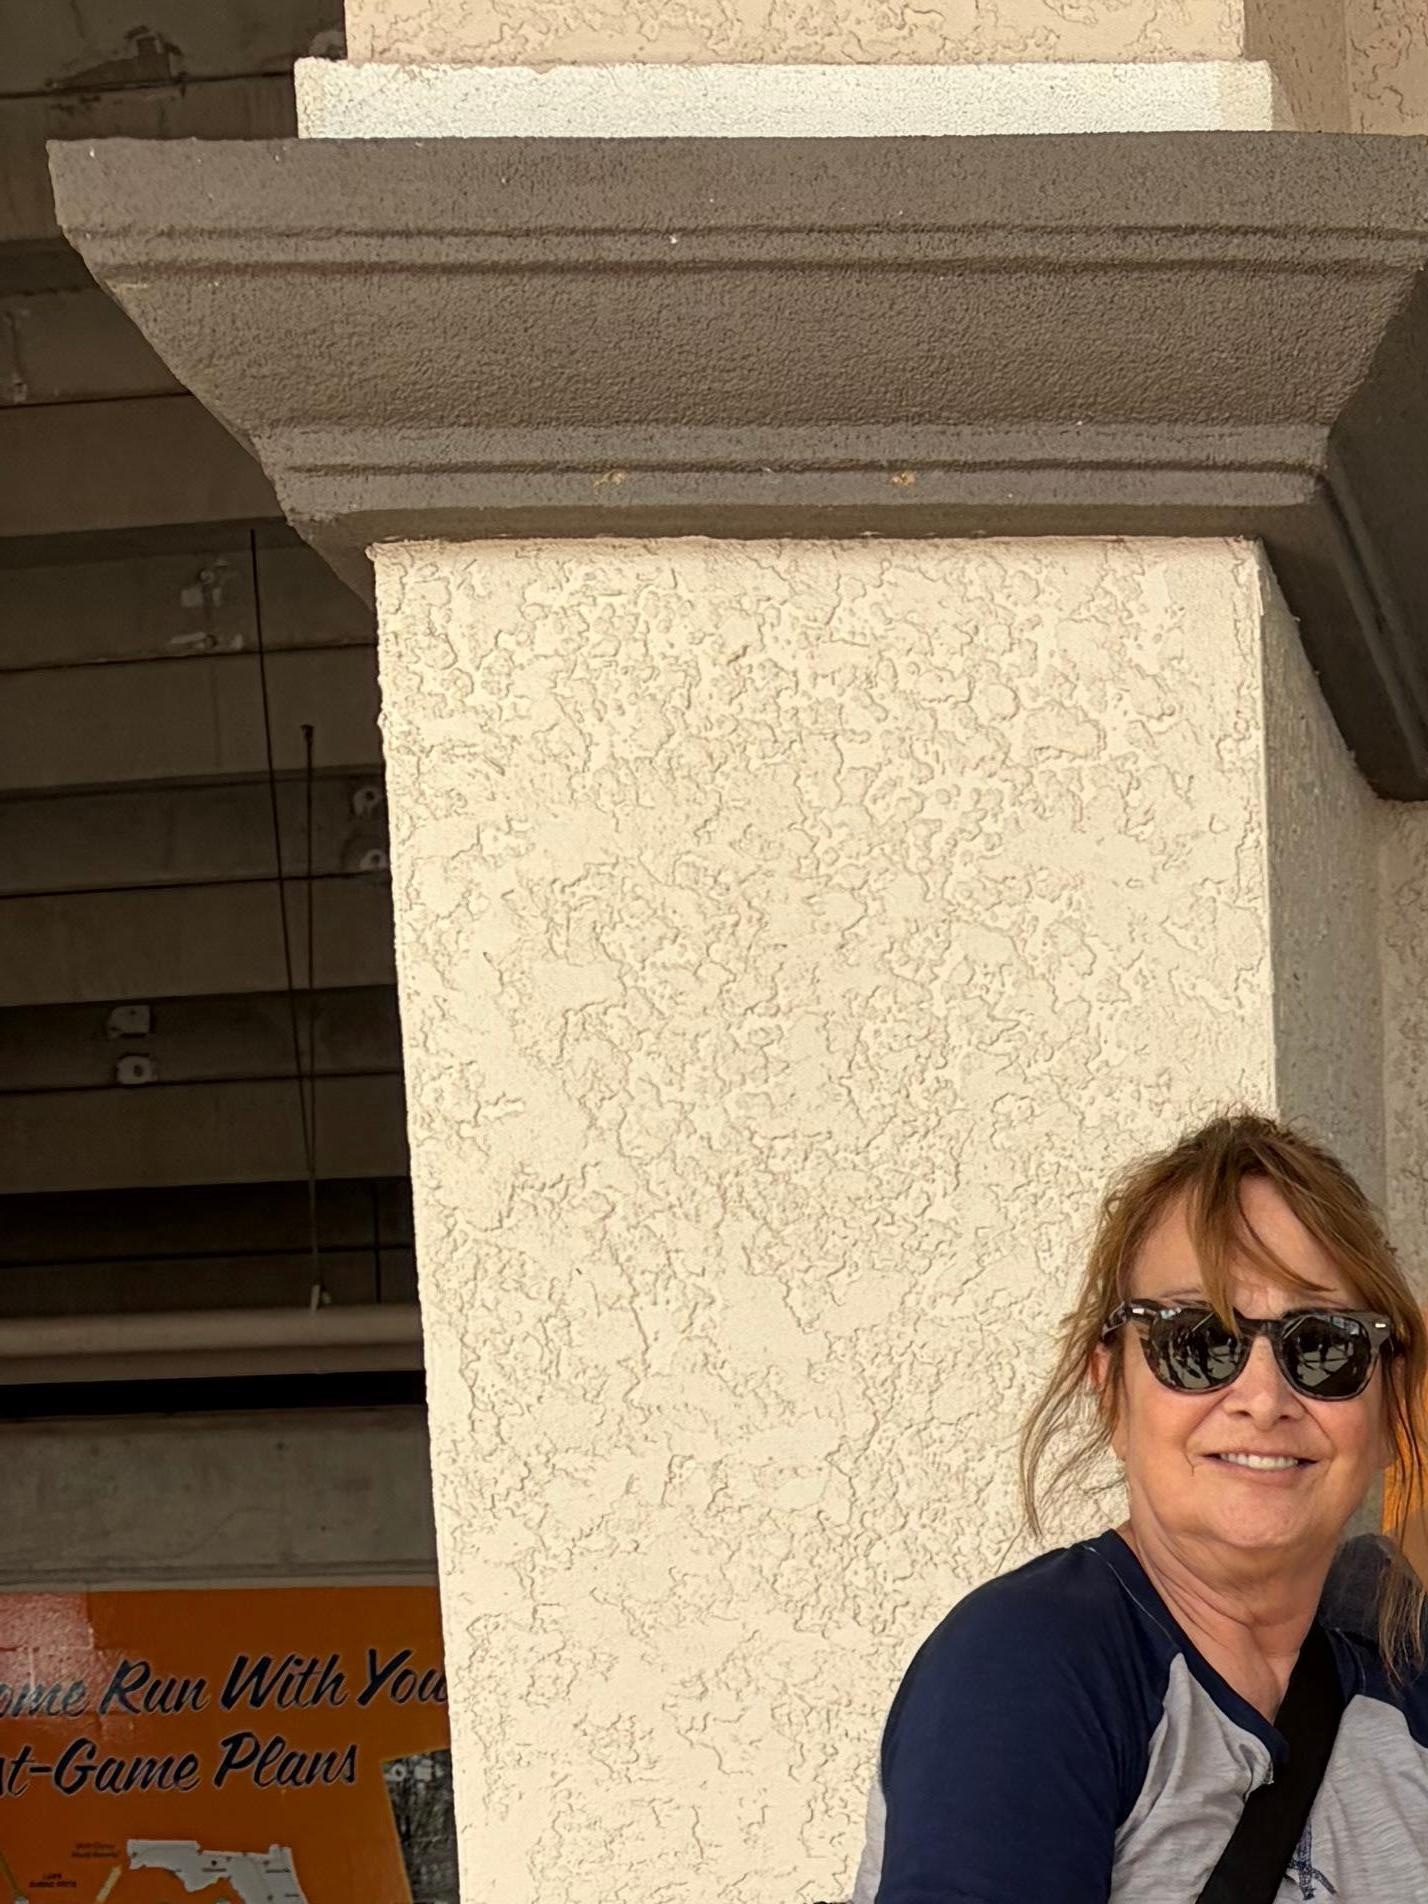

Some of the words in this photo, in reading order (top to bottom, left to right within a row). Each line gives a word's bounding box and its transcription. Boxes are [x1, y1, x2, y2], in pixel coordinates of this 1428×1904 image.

[100, 1658, 209, 1716] Run
[219, 1652, 349, 1711] With
[0, 1736, 200, 1797] t-Game
[213, 1730, 359, 1790] Plans
